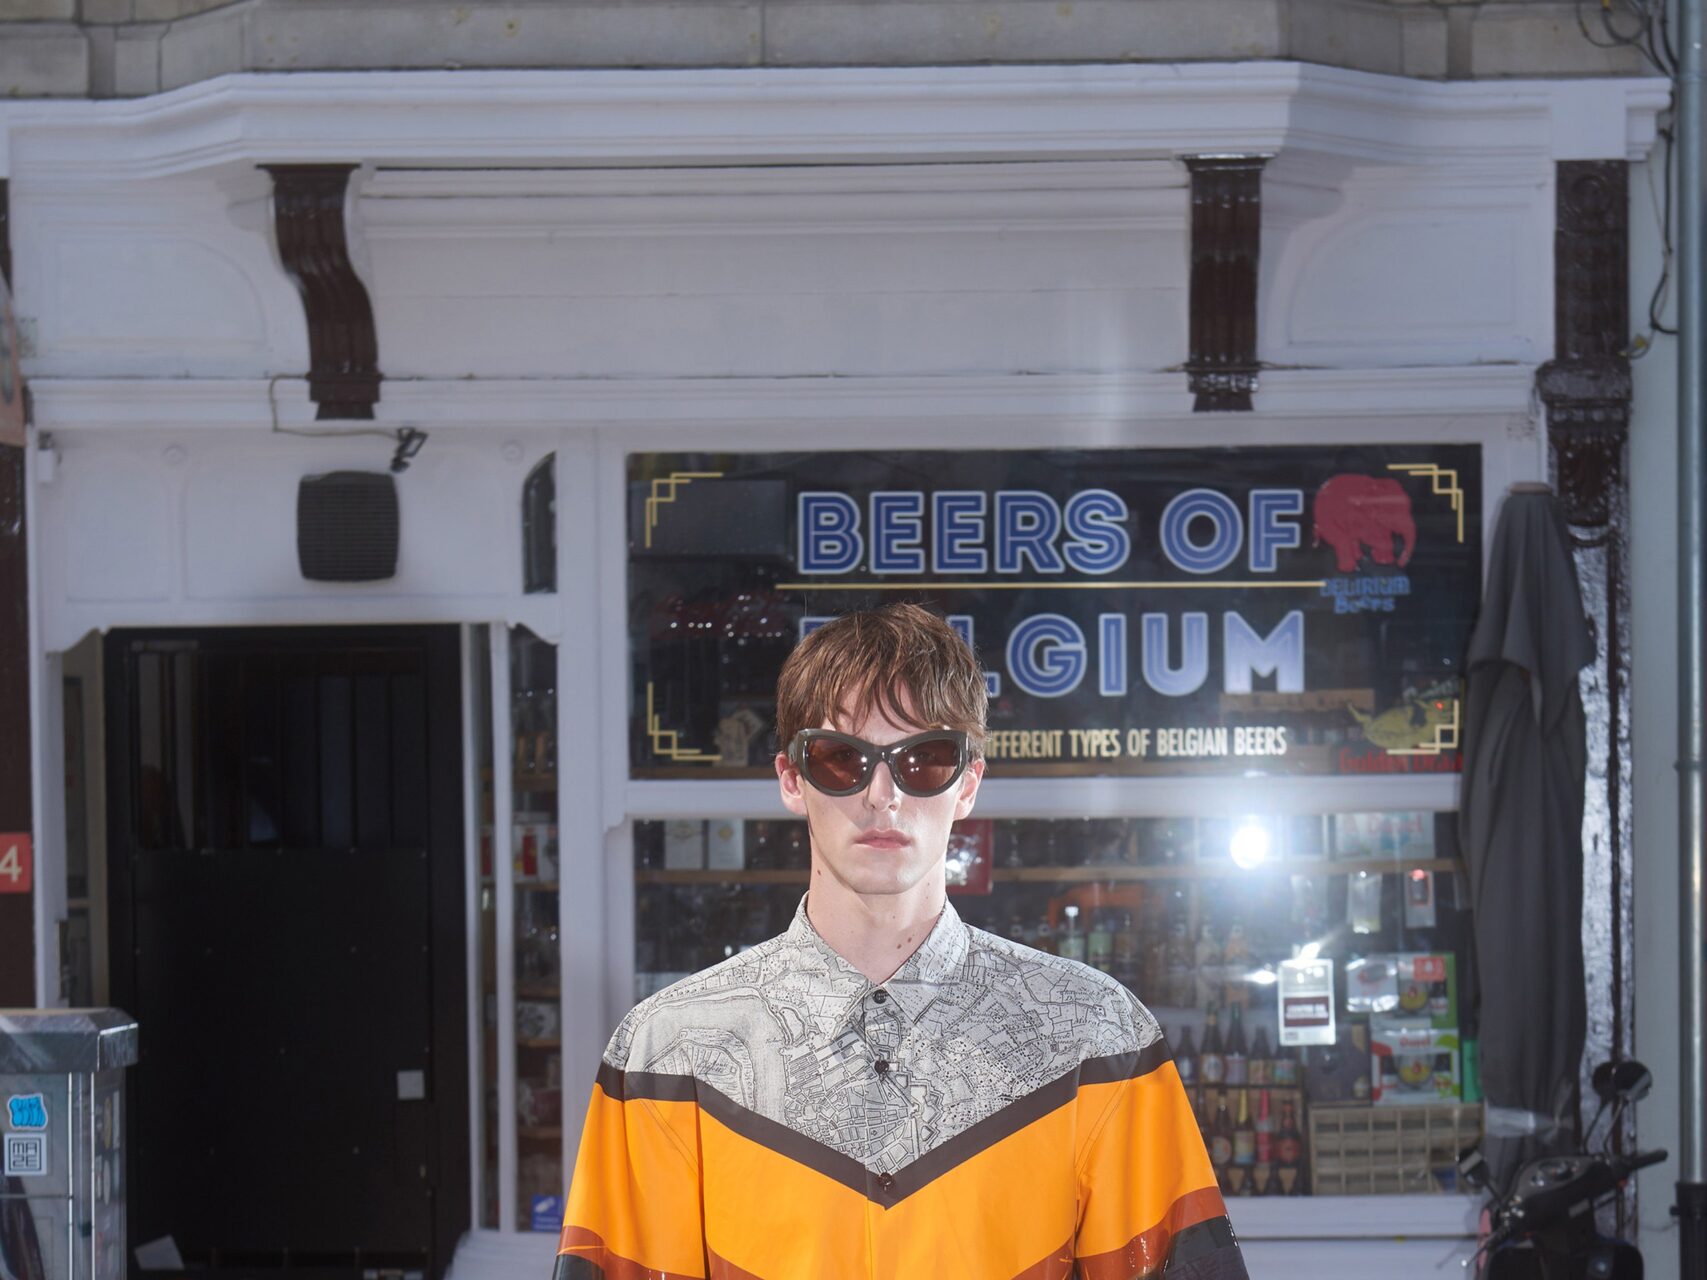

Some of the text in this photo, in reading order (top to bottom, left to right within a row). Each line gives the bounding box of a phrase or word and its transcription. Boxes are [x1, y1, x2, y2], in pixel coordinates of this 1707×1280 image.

[798, 488, 1303, 574] BEERS OF
[1069, 729, 1121, 757] TYPES
[1127, 729, 1151, 757] OF
[1157, 727, 1229, 757] BELGIAN
[1233, 726, 1288, 756] BEERS
